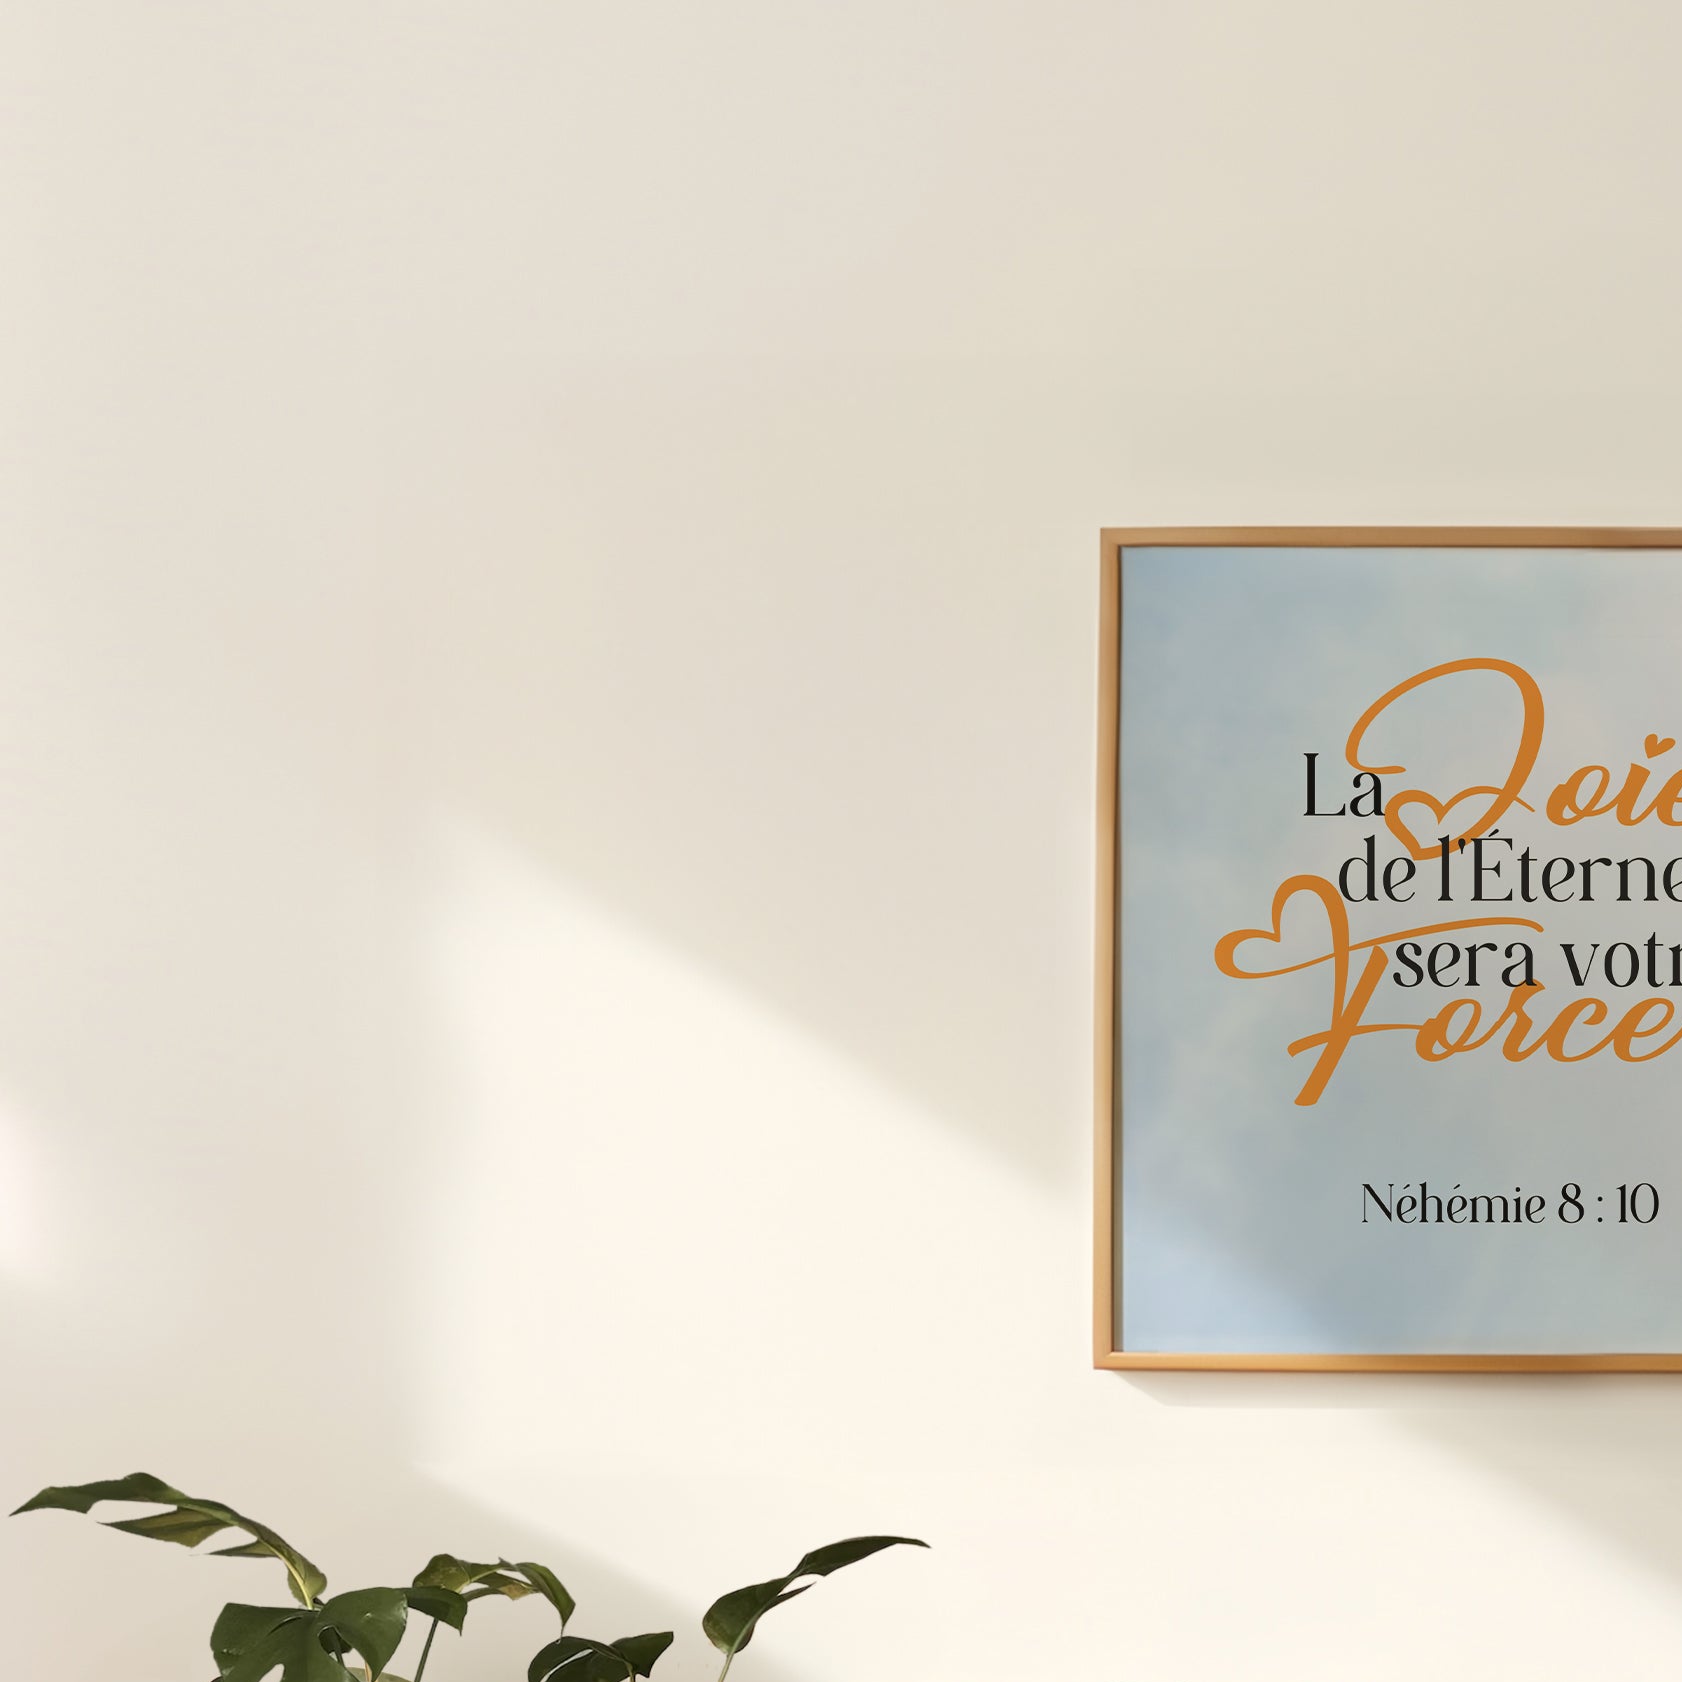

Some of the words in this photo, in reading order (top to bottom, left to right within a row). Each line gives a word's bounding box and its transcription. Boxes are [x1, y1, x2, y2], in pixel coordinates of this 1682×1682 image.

[1303, 752, 1386, 818] La
[1338, 834, 1416, 903] de
[1392, 942, 1537, 988] sera
[1361, 1181, 1546, 1224] Néhémie
[1557, 1182, 1585, 1224] 8
[1616, 1182, 1660, 1224] 10
